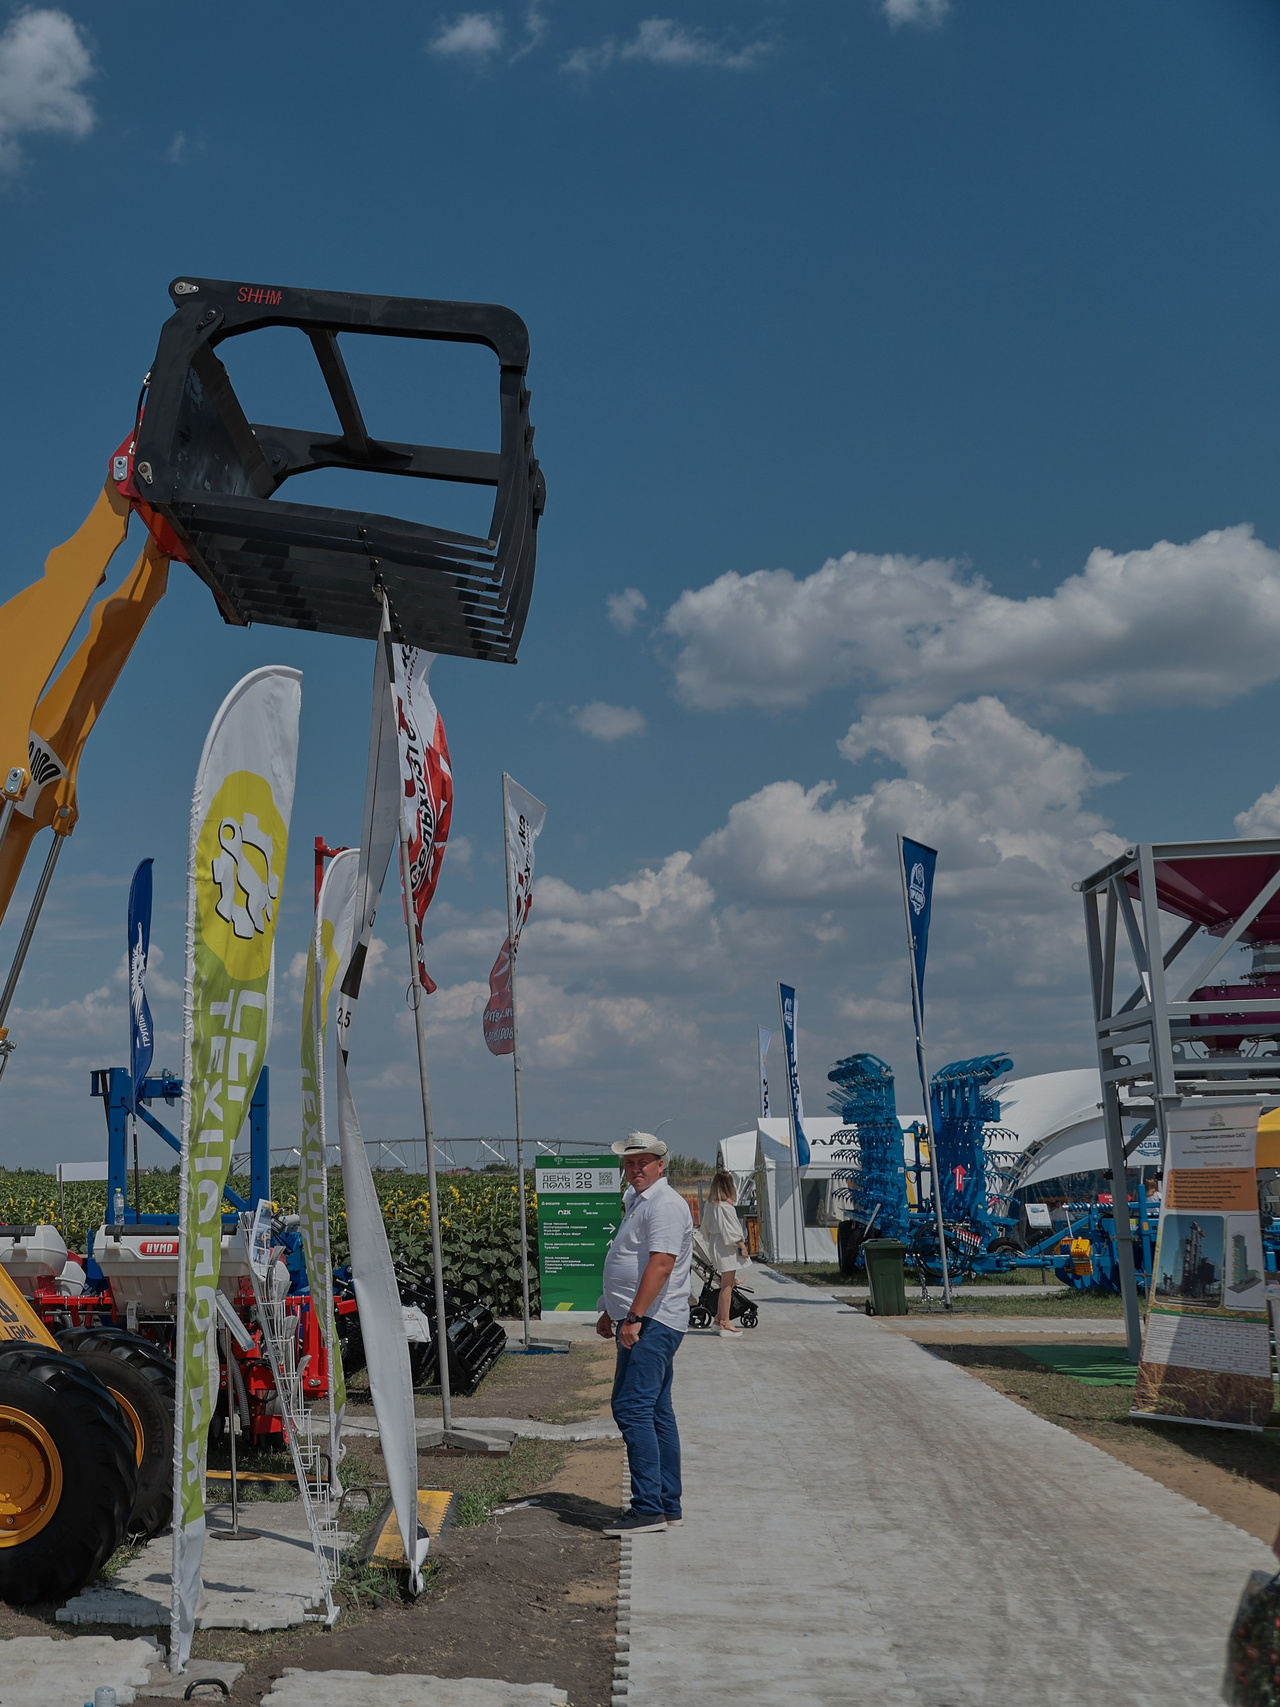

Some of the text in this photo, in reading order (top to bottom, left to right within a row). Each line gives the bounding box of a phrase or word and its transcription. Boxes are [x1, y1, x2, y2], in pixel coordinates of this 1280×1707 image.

[237, 286, 282, 306] SHHM
[337, 1007, 352, 1029] 2,5
[575, 1172, 592, 1180] 20
[575, 1181, 592, 1189] 25
[3, 1324, 37, 1341] LGMA
